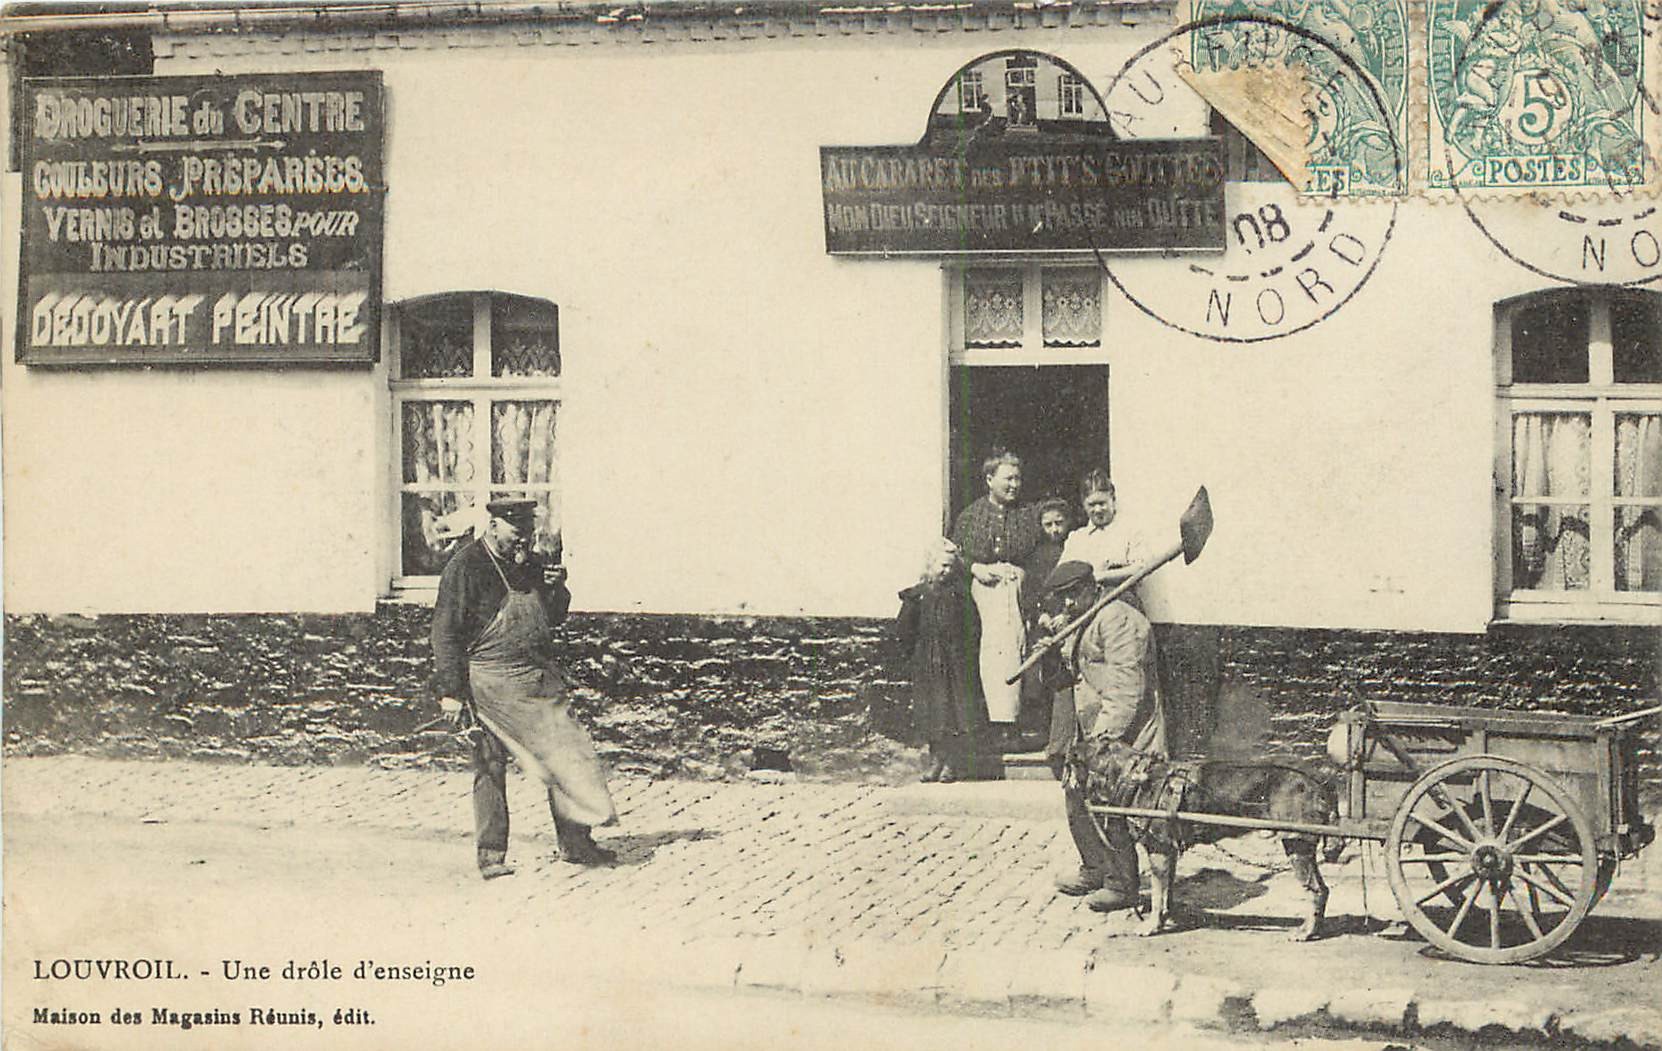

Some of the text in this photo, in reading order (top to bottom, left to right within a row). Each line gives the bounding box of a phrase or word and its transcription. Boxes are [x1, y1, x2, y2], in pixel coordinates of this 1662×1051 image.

[34, 90, 365, 139] DROGUERIE du CENTRE
[33, 159, 163, 200] COULEURS
[826, 155, 856, 190] AU
[1488, 158, 1582, 184] POSTES
[43, 204, 359, 242] VERNIS et BROSSES POUR
[828, 203, 869, 232] MON
[871, 203, 912, 231] DIEU
[913, 201, 1008, 231] SEIGNEUR
[90, 242, 309, 272] INDUSTRIELS
[1206, 233, 1366, 327] NORD
[212, 291, 369, 345] PEINTRE
